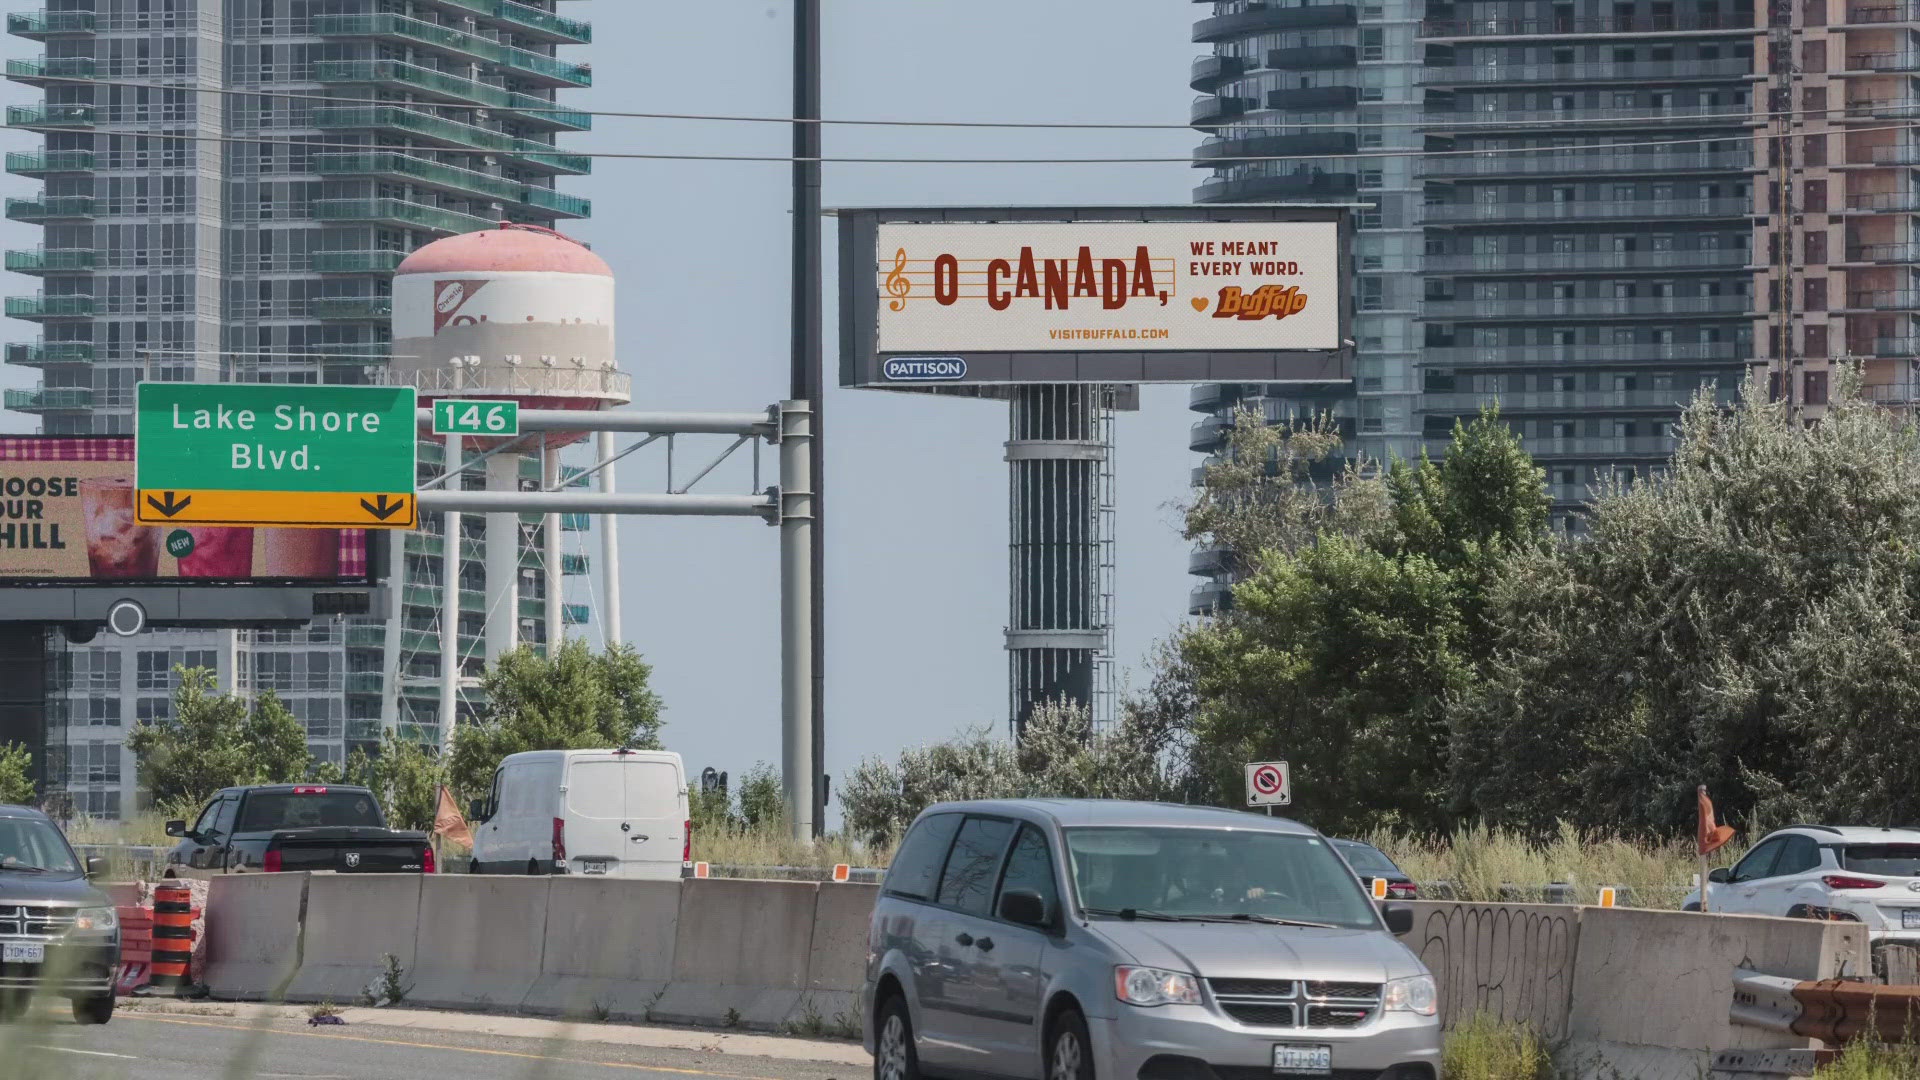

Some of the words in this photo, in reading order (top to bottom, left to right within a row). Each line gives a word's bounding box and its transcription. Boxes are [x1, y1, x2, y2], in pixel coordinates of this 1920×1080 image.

[1190, 242, 1215, 255] WE
[1221, 241, 1278, 255] MEANT
[934, 254, 958, 305] O
[987, 246, 1168, 311] CANADA,
[1190, 261, 1241, 275] EVERY
[1250, 261, 1304, 275] WORD.
[438, 285, 463, 311] Christie
[1212, 285, 1308, 320] Buffalo
[1049, 328, 1169, 339] VISITBUFFALO.COM
[890, 362, 960, 374] PATTISON
[172, 403, 256, 430] Lake
[274, 405, 380, 433] Shore
[445, 404, 506, 431] 146
[230, 443, 321, 471] Blvd.
[0, 476, 78, 497] OOSE
[0, 500, 44, 519] UR
[170, 536, 190, 552] NEW
